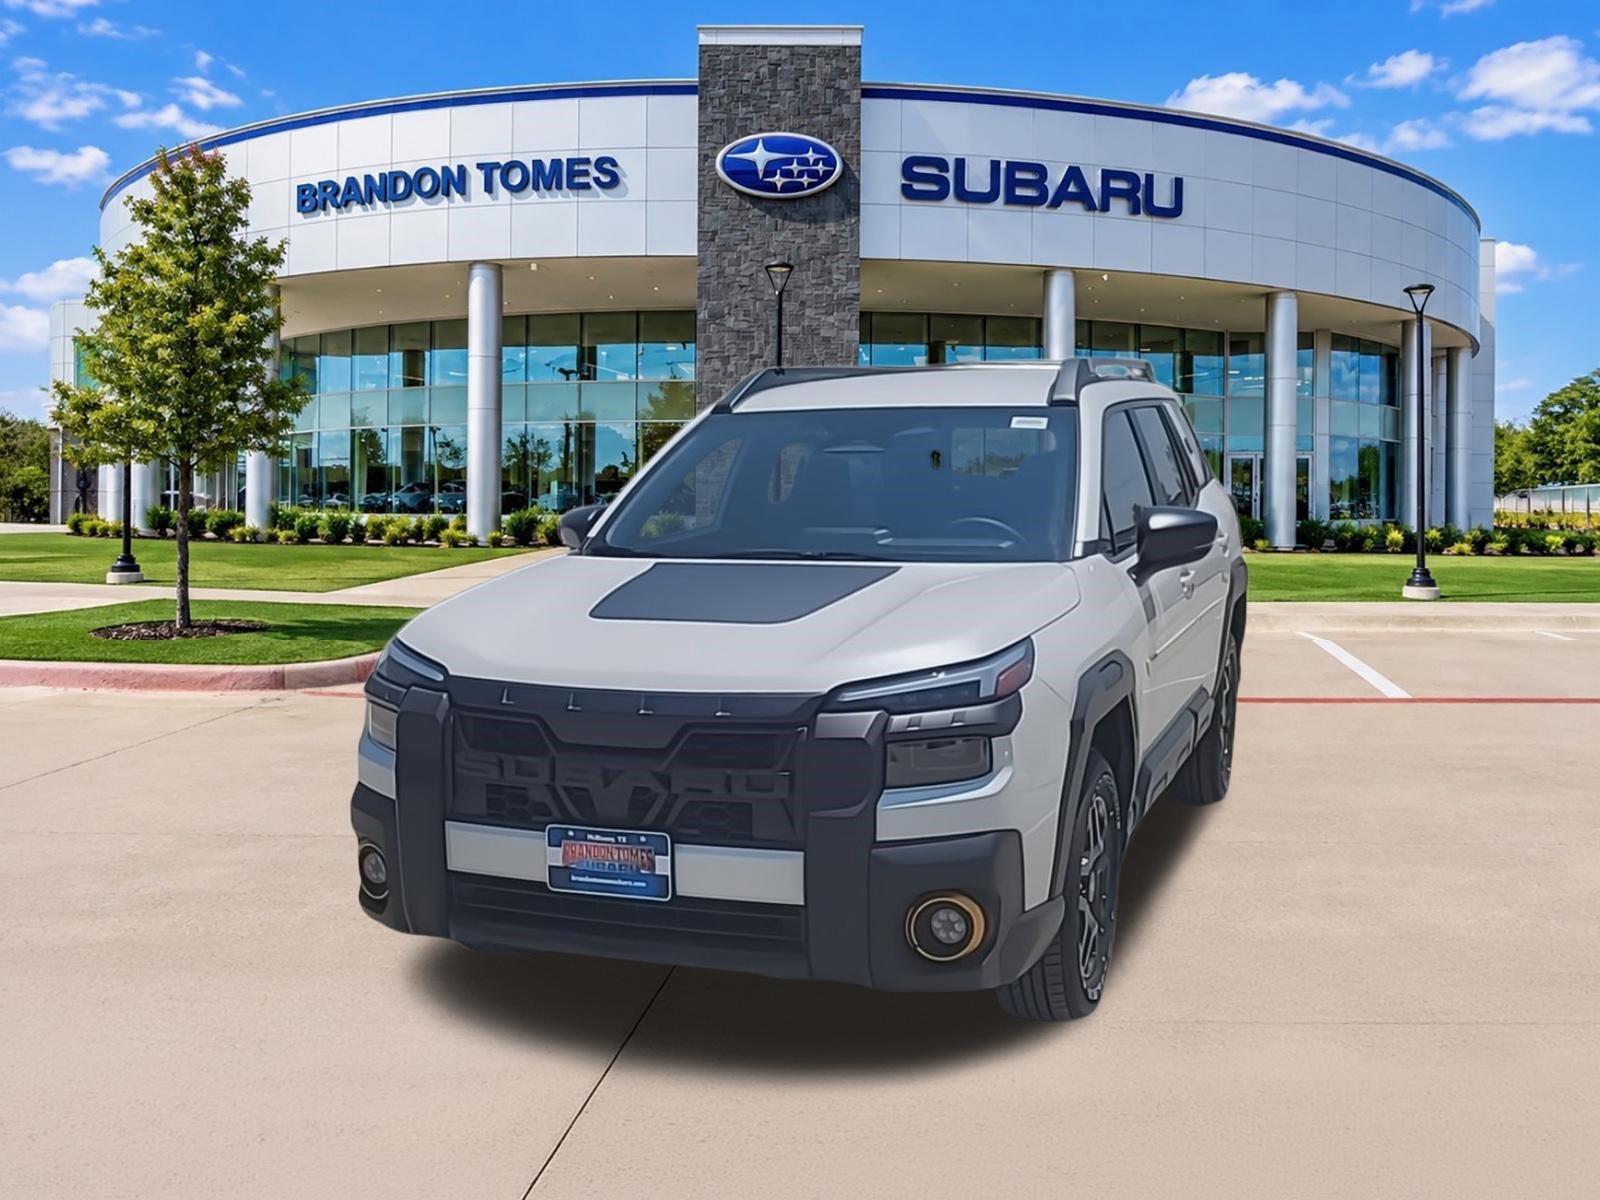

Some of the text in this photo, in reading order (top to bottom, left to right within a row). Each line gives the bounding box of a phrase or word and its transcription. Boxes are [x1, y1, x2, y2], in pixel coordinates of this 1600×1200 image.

[297, 156, 620, 213] BRANDON TOMES
[901, 155, 1184, 218] SUBARU
